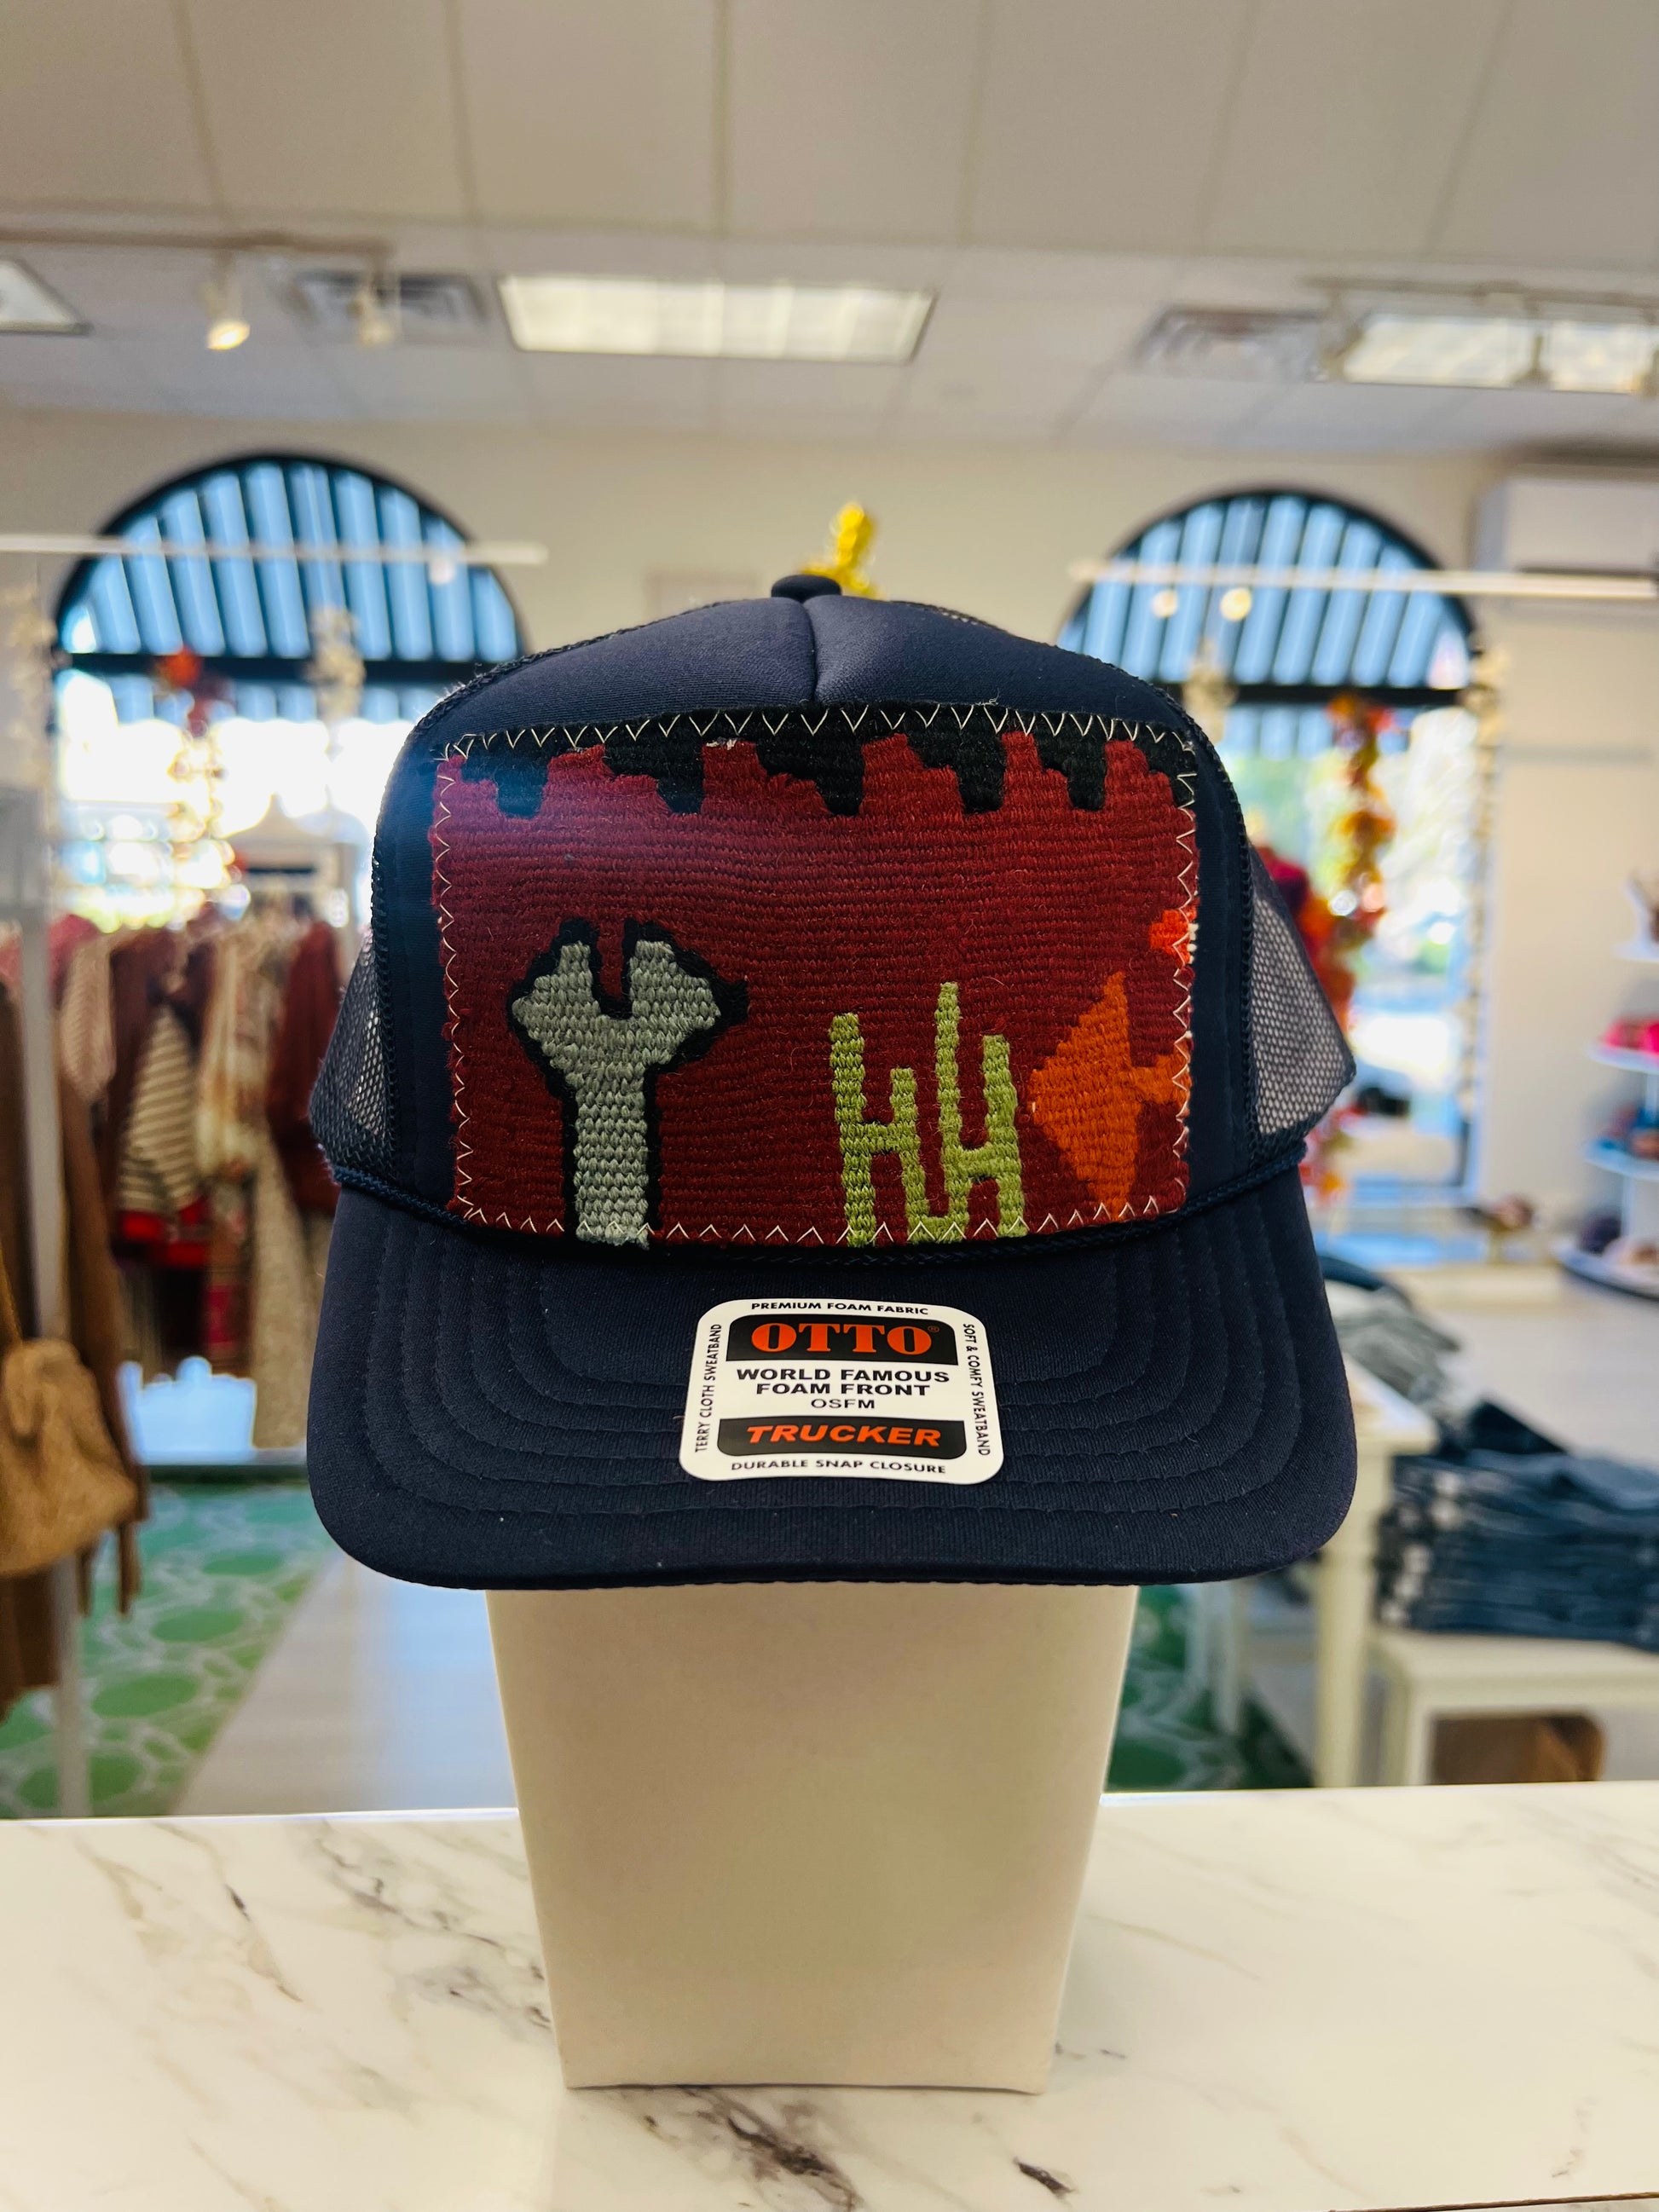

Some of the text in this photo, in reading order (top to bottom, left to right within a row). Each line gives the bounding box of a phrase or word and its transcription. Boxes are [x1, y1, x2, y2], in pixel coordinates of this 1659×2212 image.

[751, 1302, 928, 1314] PREMIUM FOAM FABRIC
[963, 1324, 976, 1343] SOFT
[737, 1368, 950, 1383] WORLD FAMOUS
[968, 1354, 983, 1389] COMFY
[695, 1324, 722, 1453] TERRY CLOTH SWEATBAND
[756, 1383, 930, 1395] FOAM FRONT
[811, 1399, 875, 1409] OSFM
[972, 1391, 991, 1456] SWEATBAND
[747, 1425, 941, 1447] TRUCKER
[731, 1459, 945, 1473] DURABLE SNAP CLOSURE
